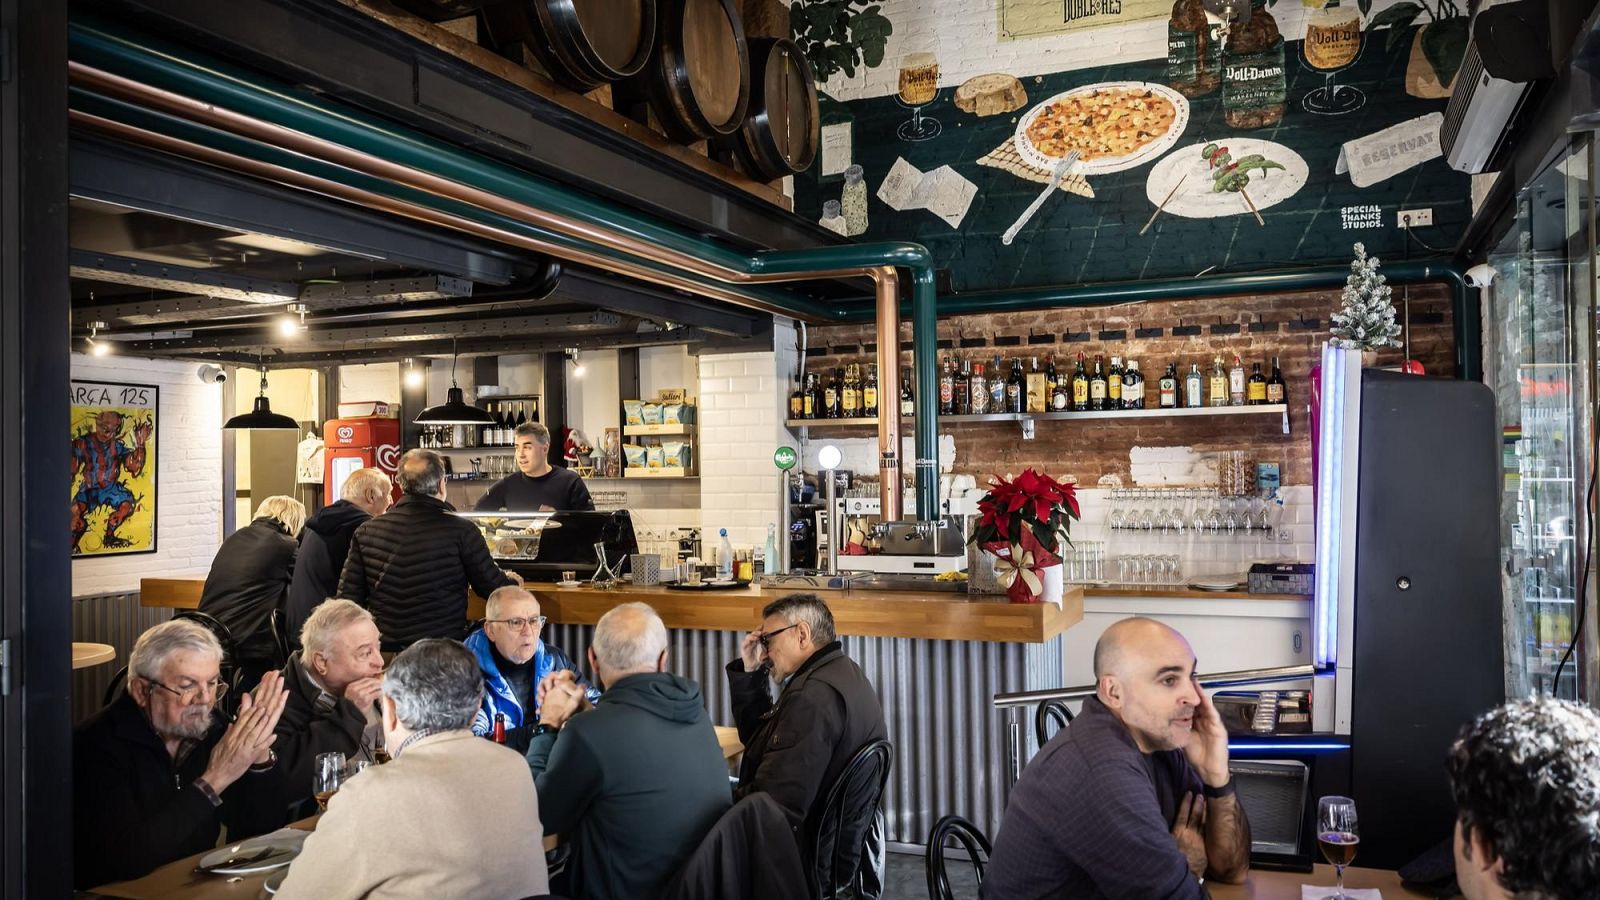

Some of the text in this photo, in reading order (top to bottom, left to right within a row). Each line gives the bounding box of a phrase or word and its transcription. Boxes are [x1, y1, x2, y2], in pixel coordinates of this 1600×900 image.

[1361, 131, 1434, 167] RESERVAT
[1341, 204, 1382, 215] SPECIAL
[1341, 212, 1381, 222] THANKS
[1342, 219, 1385, 230] STUDIOS.
[119, 387, 149, 406] 125
